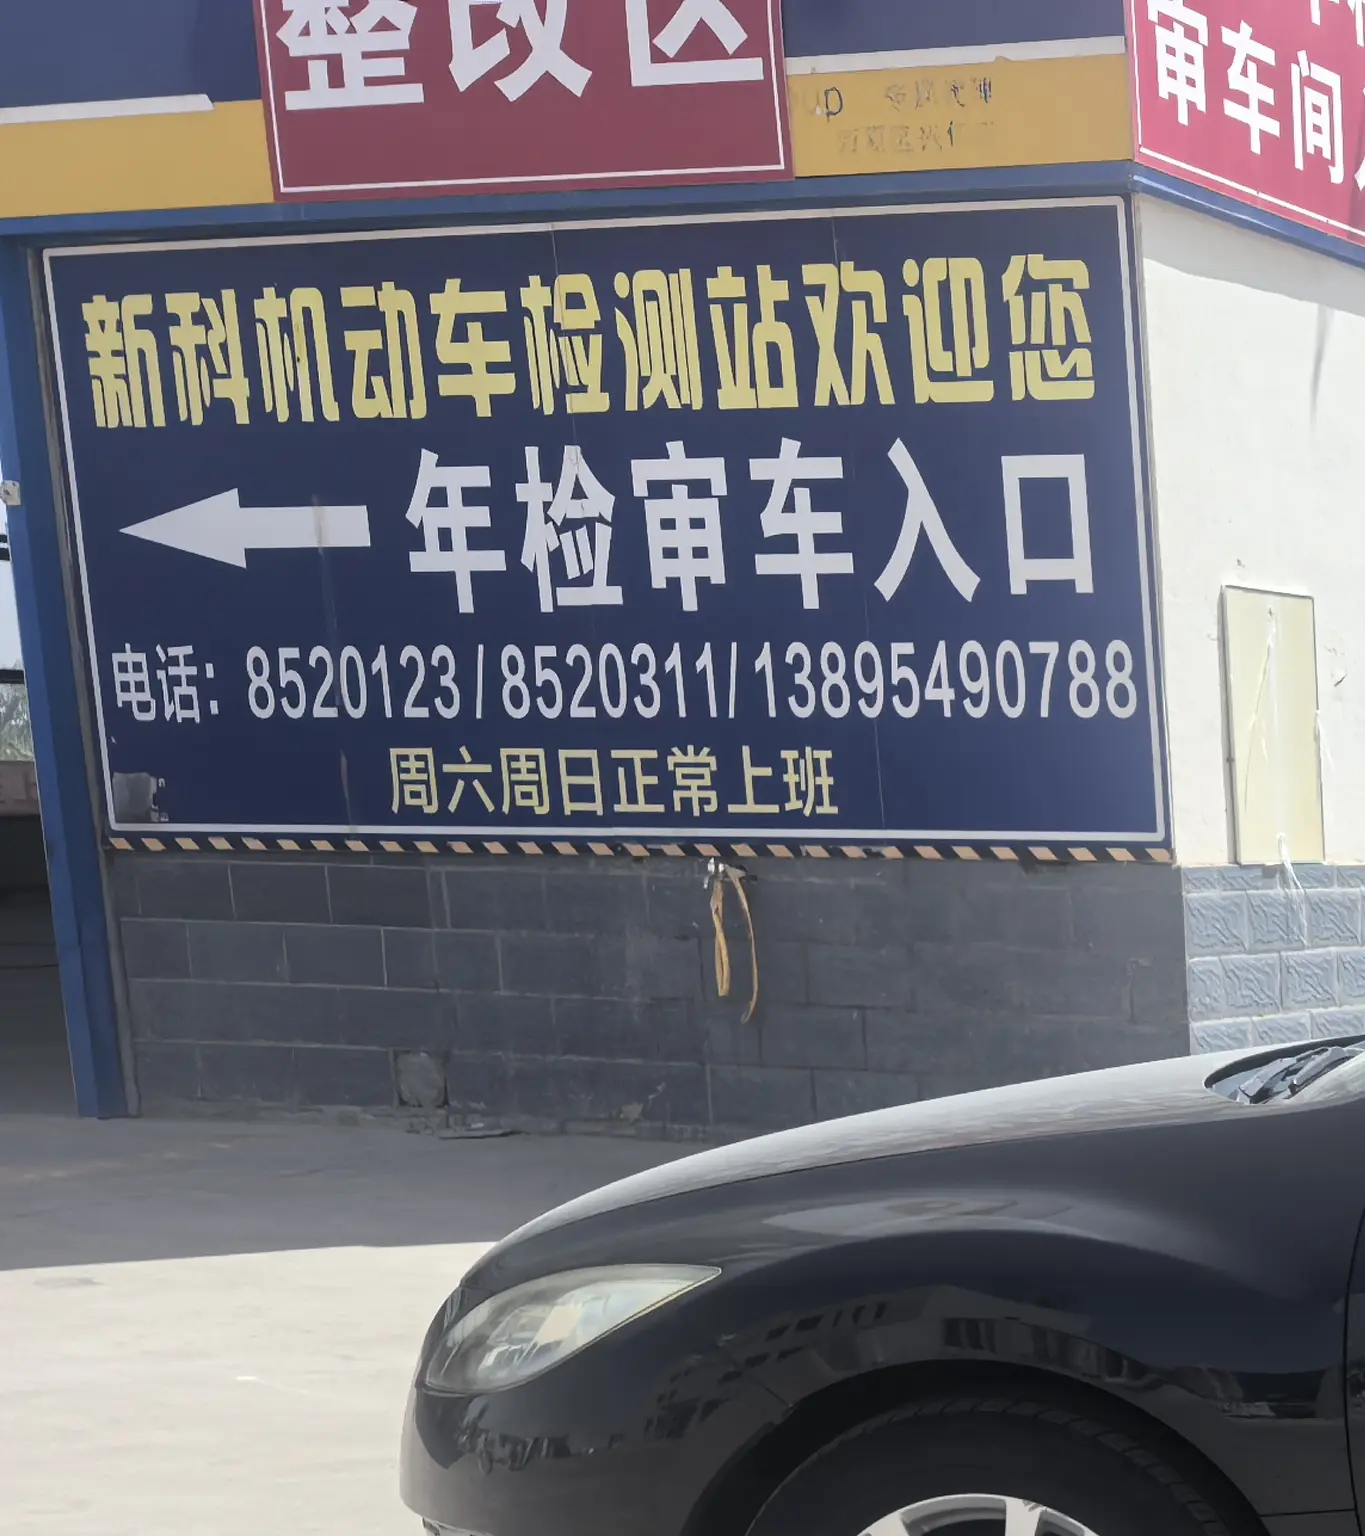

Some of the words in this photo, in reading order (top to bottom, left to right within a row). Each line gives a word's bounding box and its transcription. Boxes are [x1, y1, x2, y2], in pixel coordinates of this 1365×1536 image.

[82, 253, 1095, 429] 新科机动车检测站欢迎您
[405, 437, 1095, 614] 年检审车入口
[388, 746, 839, 818] 周六周日正常上班
